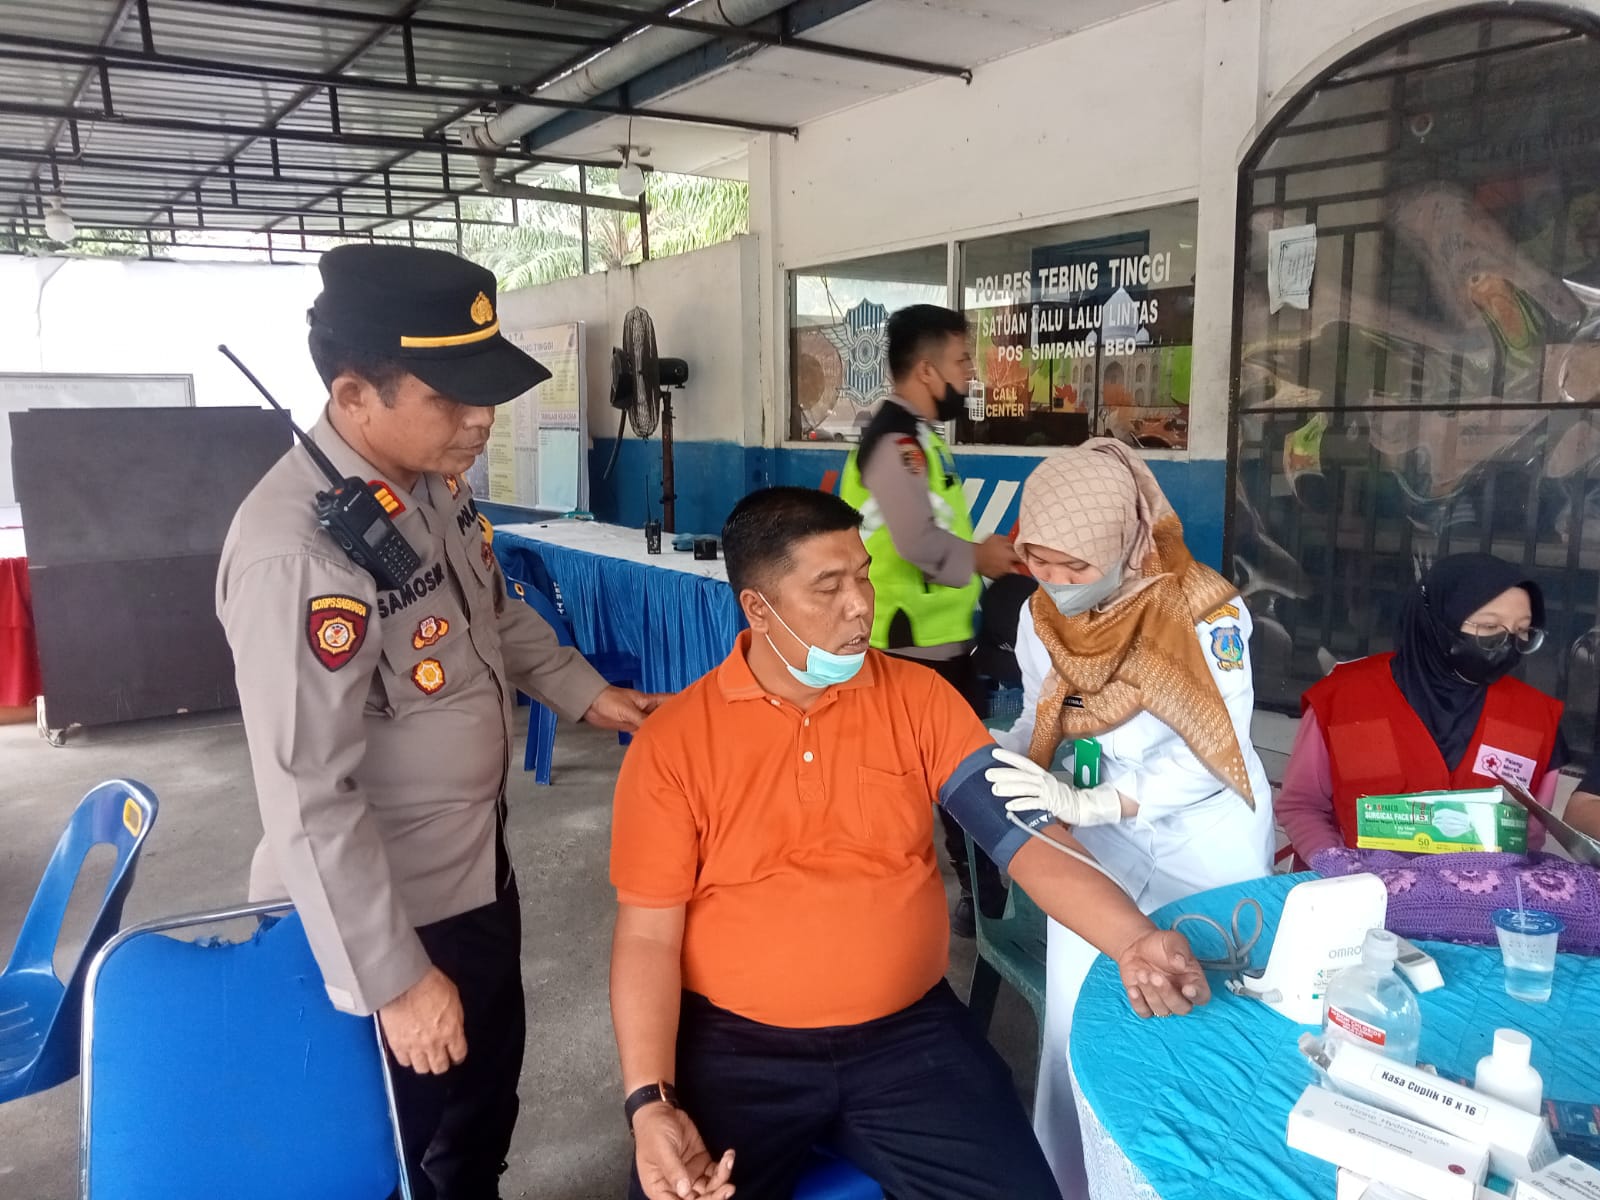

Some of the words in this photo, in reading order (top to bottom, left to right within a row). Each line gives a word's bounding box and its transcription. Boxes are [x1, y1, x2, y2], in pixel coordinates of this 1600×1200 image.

[975, 271, 1032, 303] POLRES
[1038, 262, 1098, 295] TEBING
[1109, 252, 1171, 288] TINGGI
[982, 311, 1027, 337] SATUAN
[1033, 307, 1063, 332] LALU
[1068, 304, 1102, 330] LALU
[1108, 299, 1158, 327] LINTAS
[998, 345, 1023, 362] POS
[1031, 340, 1095, 360] SIMPANG
[1105, 337, 1136, 356] BEO
[992, 387, 1018, 401] CALL
[985, 403, 1025, 418] CENTER
[1418, 837, 1430, 847] 50
[1328, 945, 1362, 959] OMRO
[1381, 1070, 1406, 1087] Kasa
[1408, 1081, 1440, 1101] Cuplik
[1442, 1095, 1453, 1106] 16
[1465, 1104, 1477, 1116] 16
